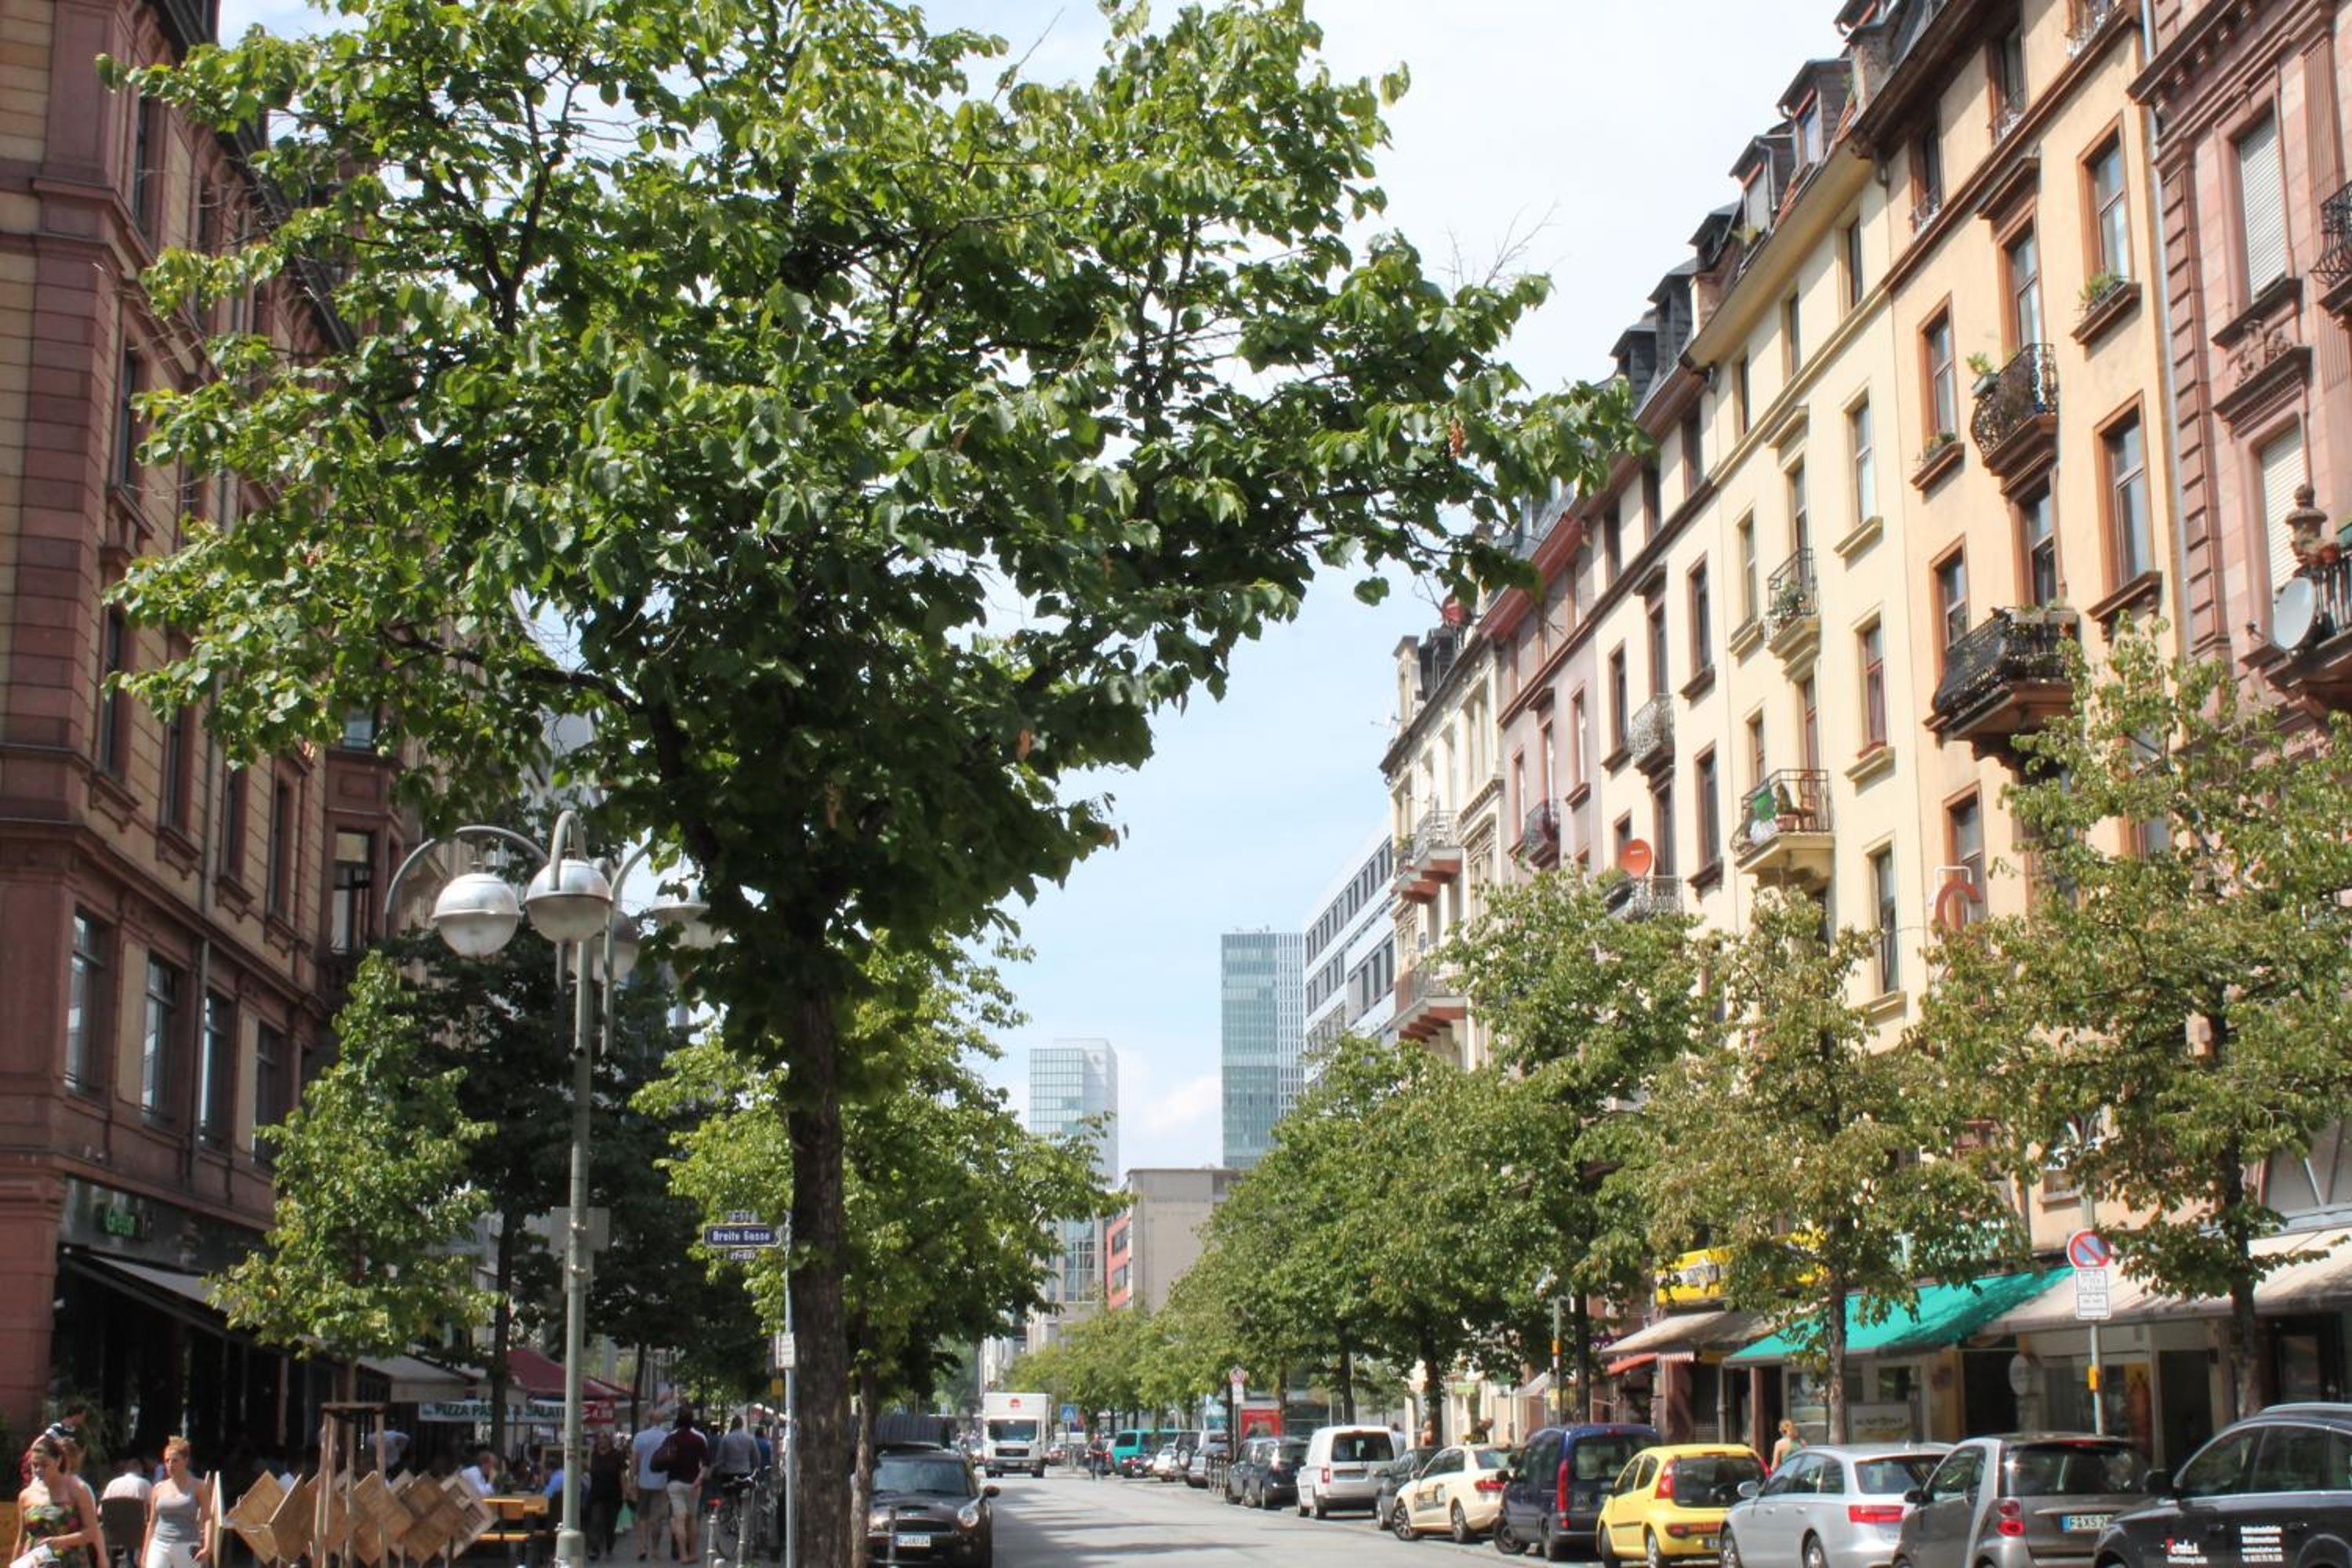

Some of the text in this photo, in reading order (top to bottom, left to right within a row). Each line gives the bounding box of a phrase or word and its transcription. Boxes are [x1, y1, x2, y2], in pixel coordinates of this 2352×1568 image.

[713, 1230, 771, 1241] Breite Gasse
[434, 1404, 469, 1417] PIZZA
